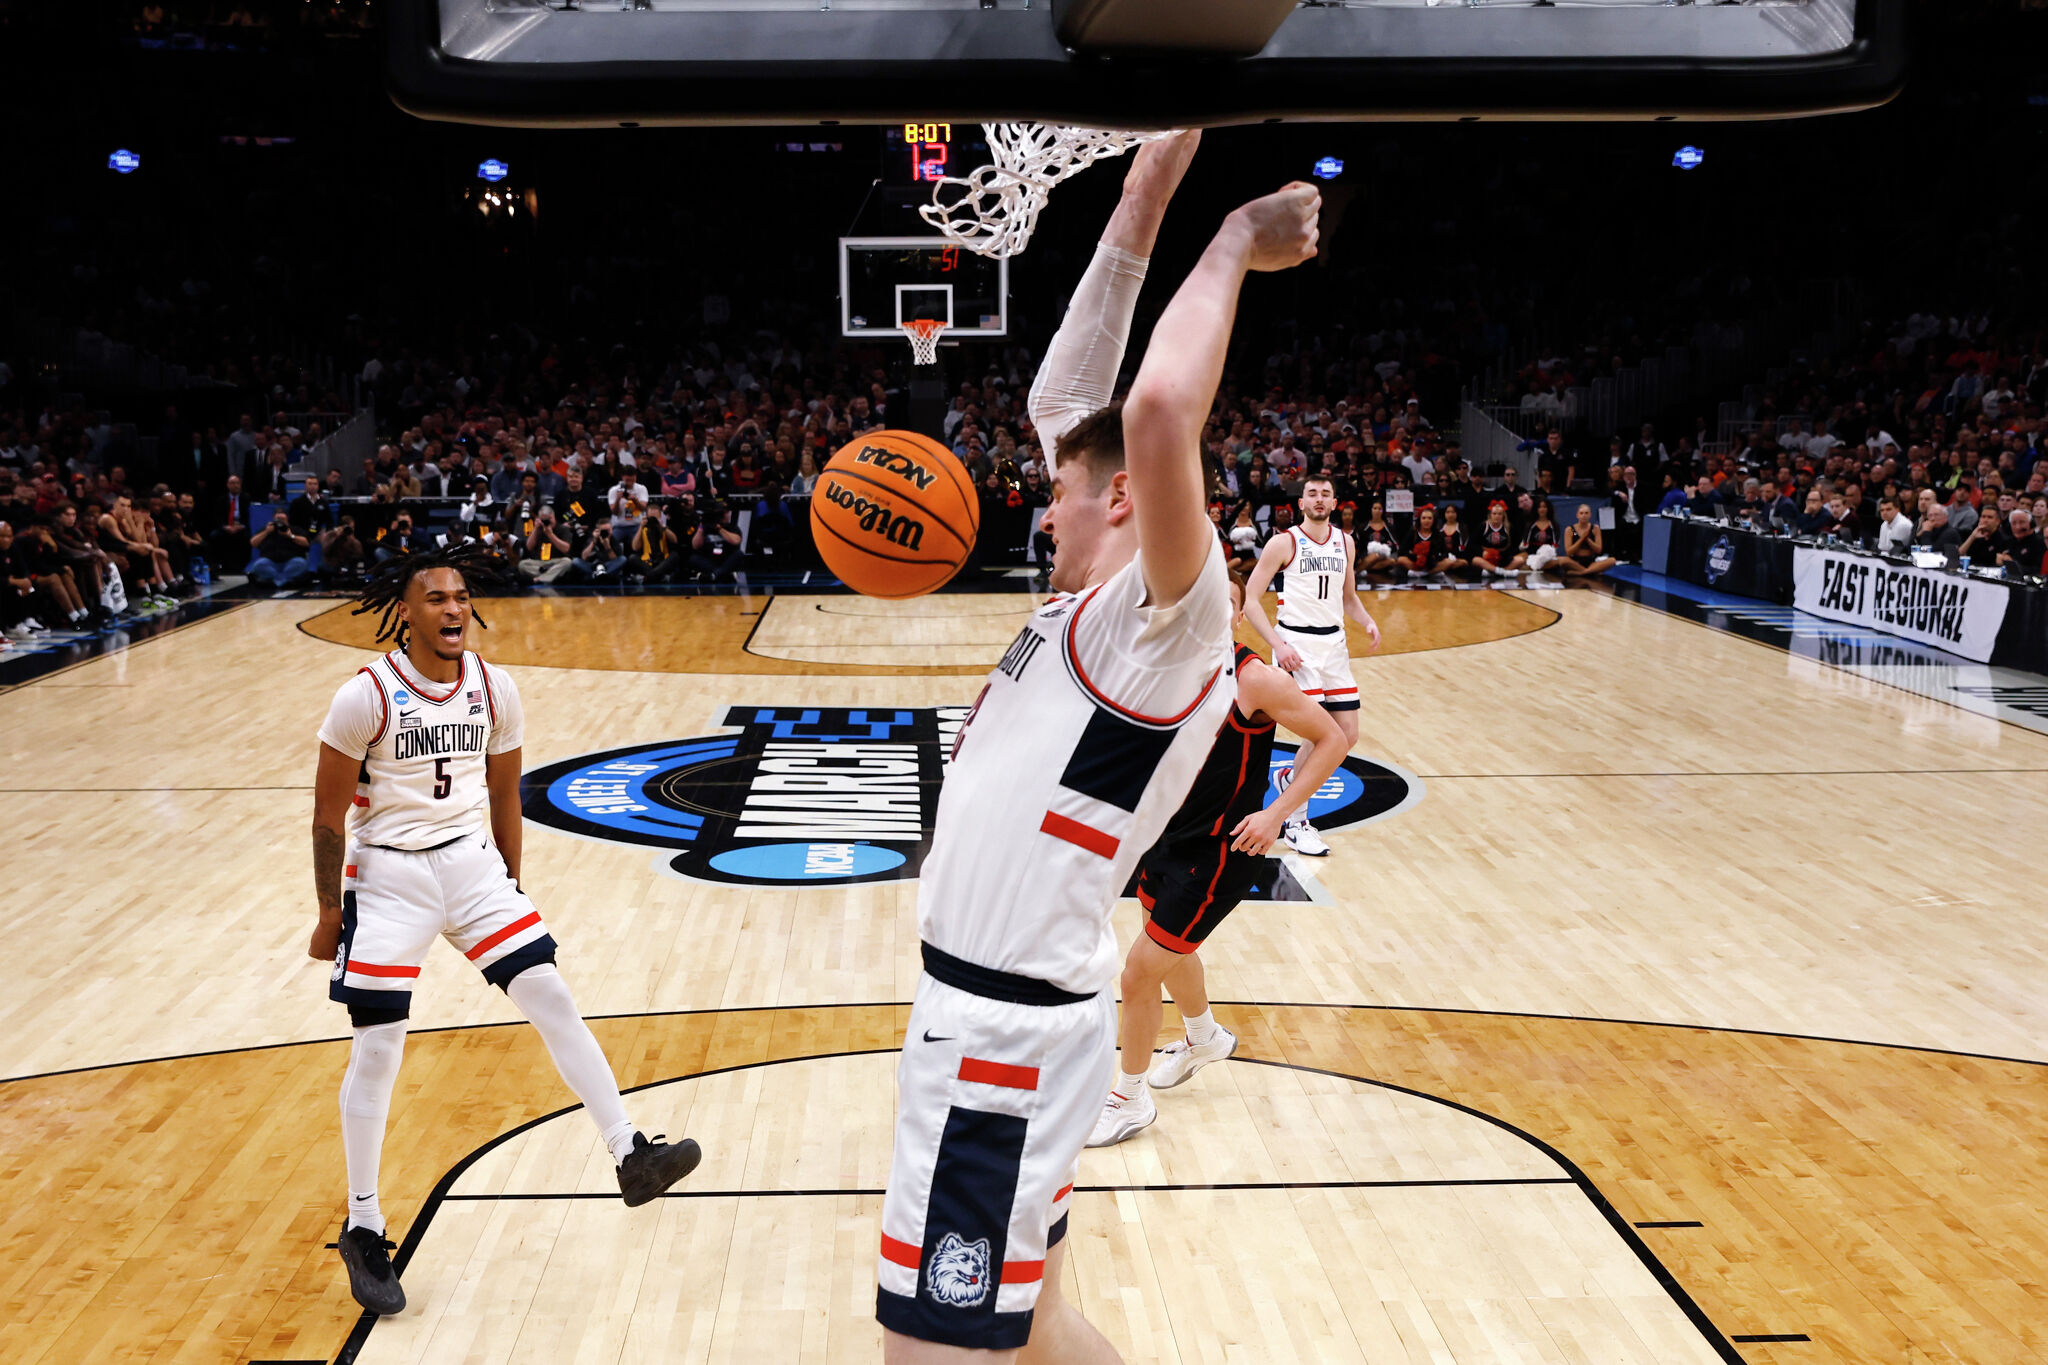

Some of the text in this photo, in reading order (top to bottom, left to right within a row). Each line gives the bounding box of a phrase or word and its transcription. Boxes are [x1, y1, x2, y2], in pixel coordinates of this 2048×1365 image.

[905, 123, 951, 143] 8:07
[912, 143, 948, 181] 12
[854, 445, 938, 491] NCAA
[825, 480, 924, 551] Wilson
[1299, 556, 1344, 574] CONNECTICUT
[1318, 575, 1329, 600] 11
[1819, 559, 1969, 643] EAST REGIONAL
[395, 723, 485, 760] CONNECTICUT
[433, 757, 452, 800] 5
[566, 763, 659, 815] SWEET 16
[733, 743, 922, 840] MARCH
[803, 843, 855, 874] NCAA
